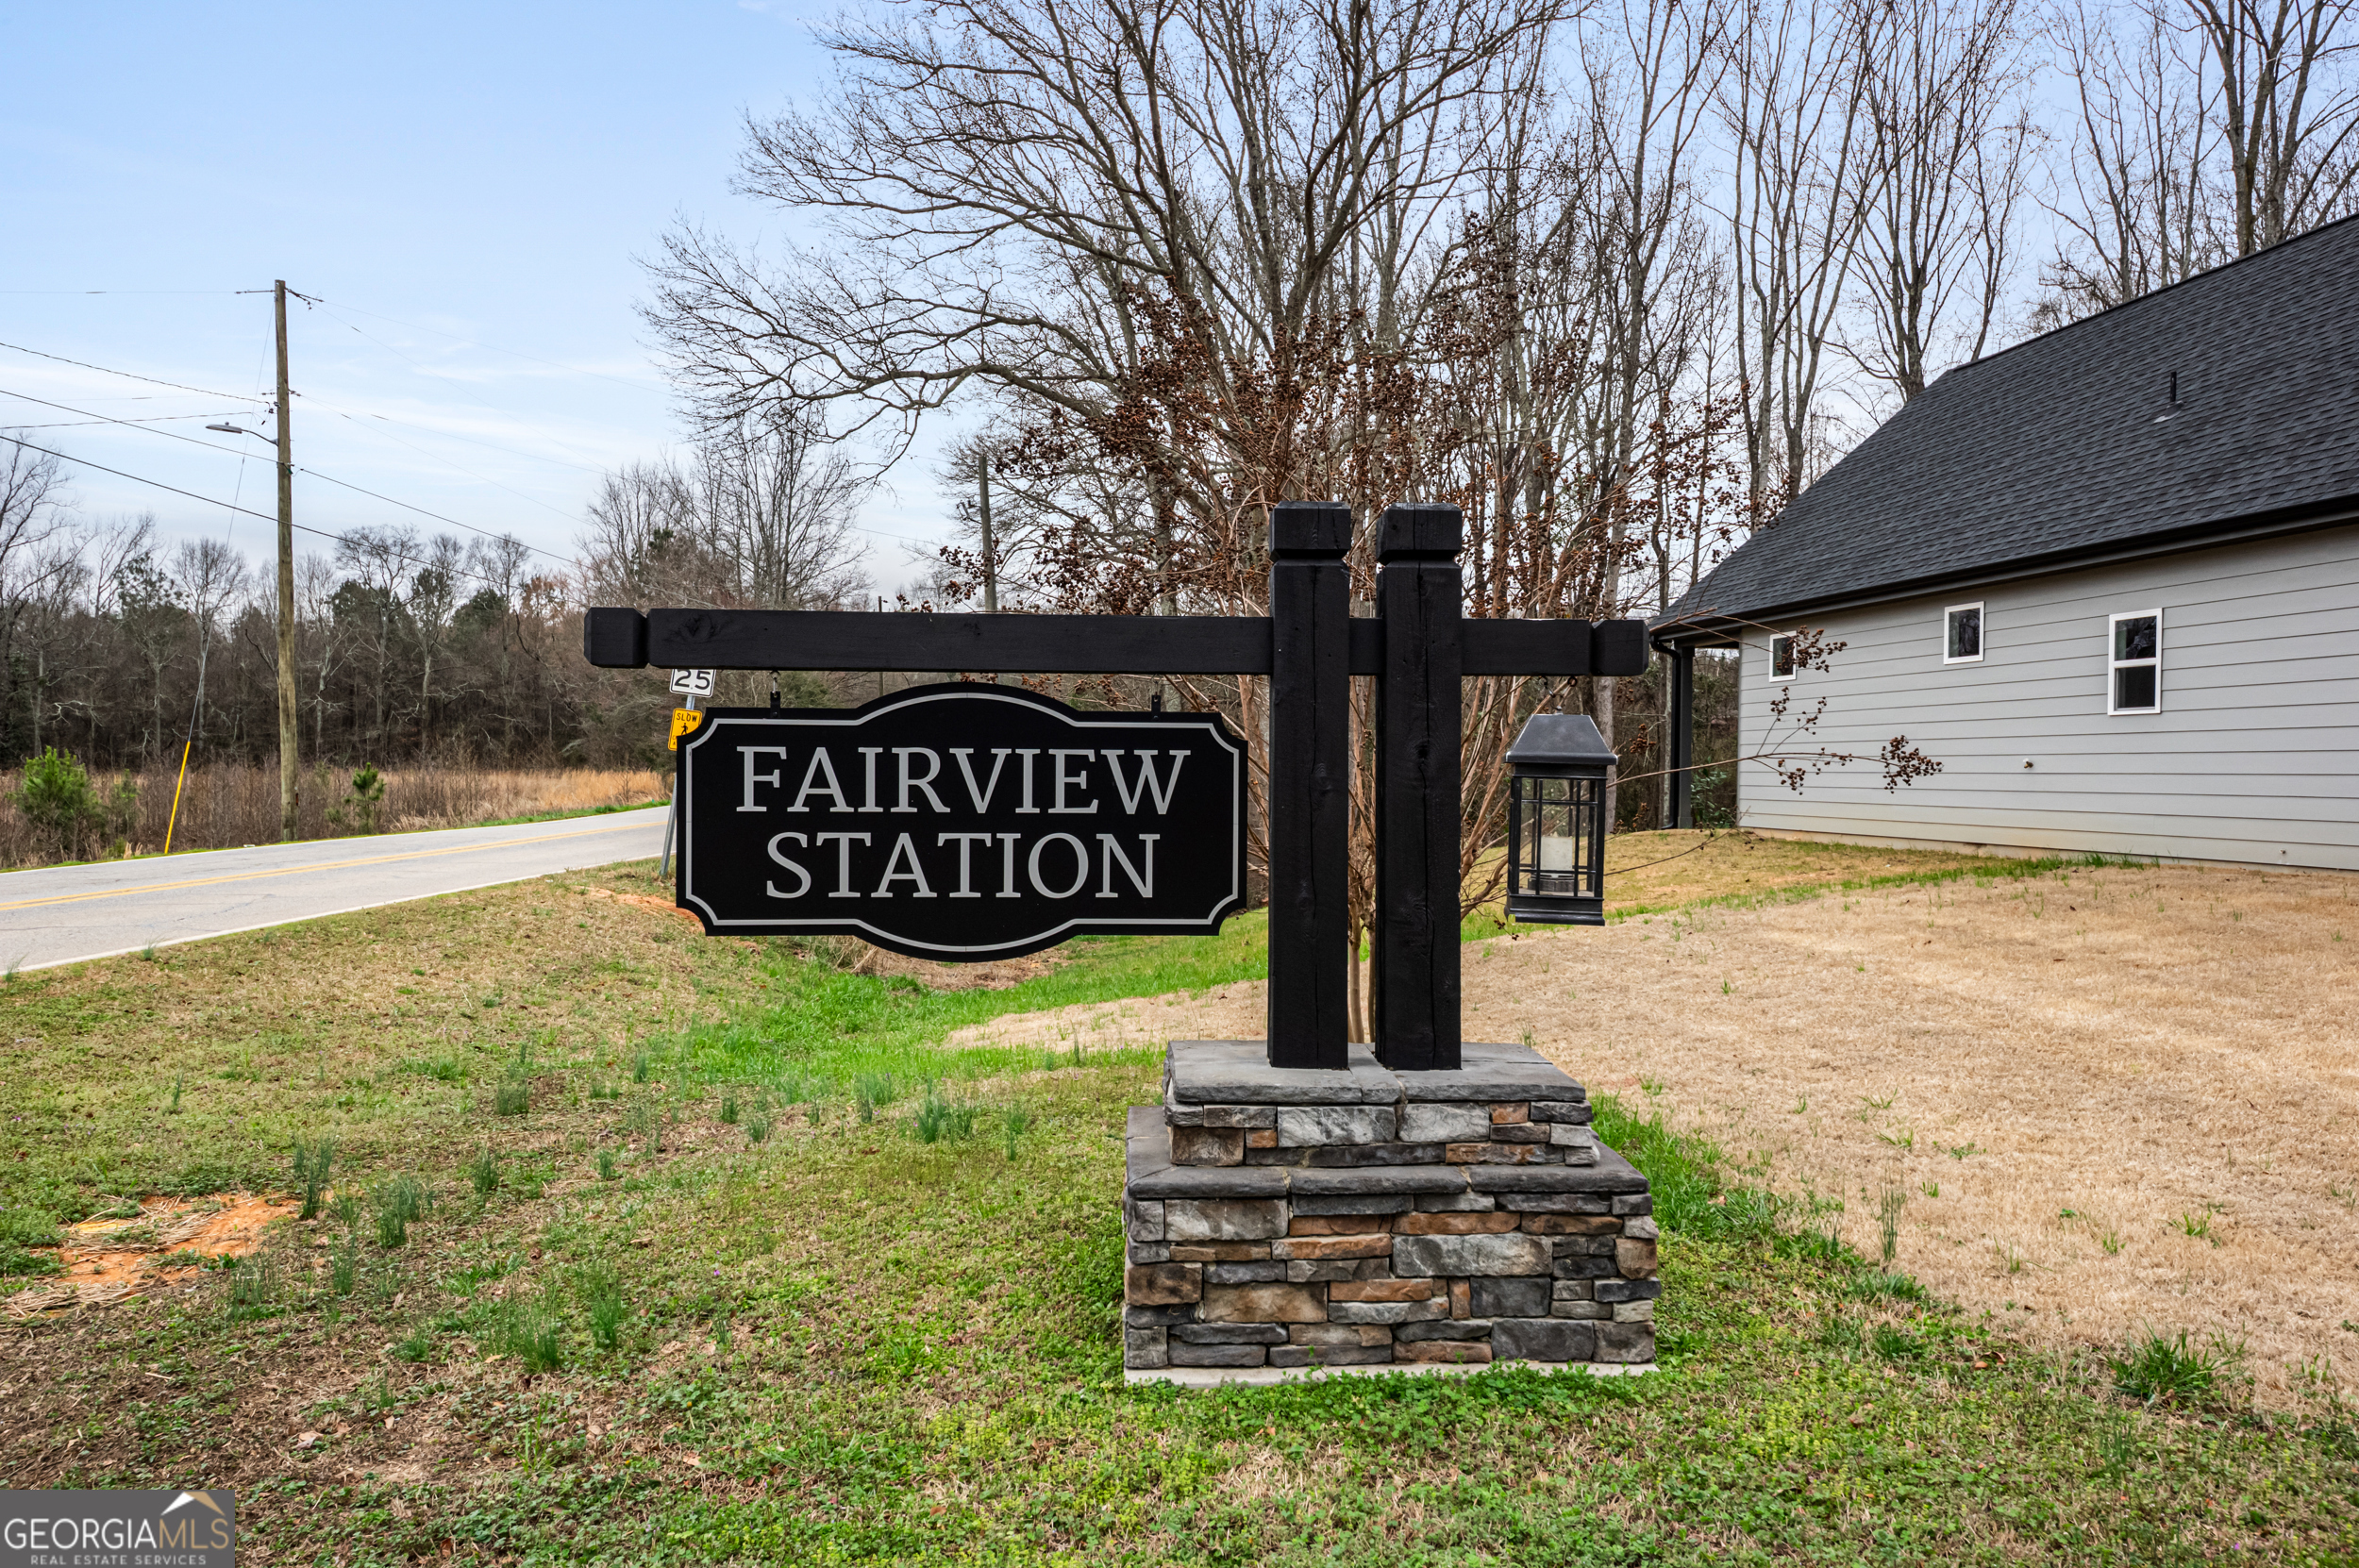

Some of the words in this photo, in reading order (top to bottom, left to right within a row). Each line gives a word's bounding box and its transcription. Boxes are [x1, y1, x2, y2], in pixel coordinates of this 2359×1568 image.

[674, 669, 711, 690] 25
[676, 713, 697, 722] SLOW
[736, 745, 1192, 815] FAIRVIEW
[766, 831, 1161, 899] STATION
